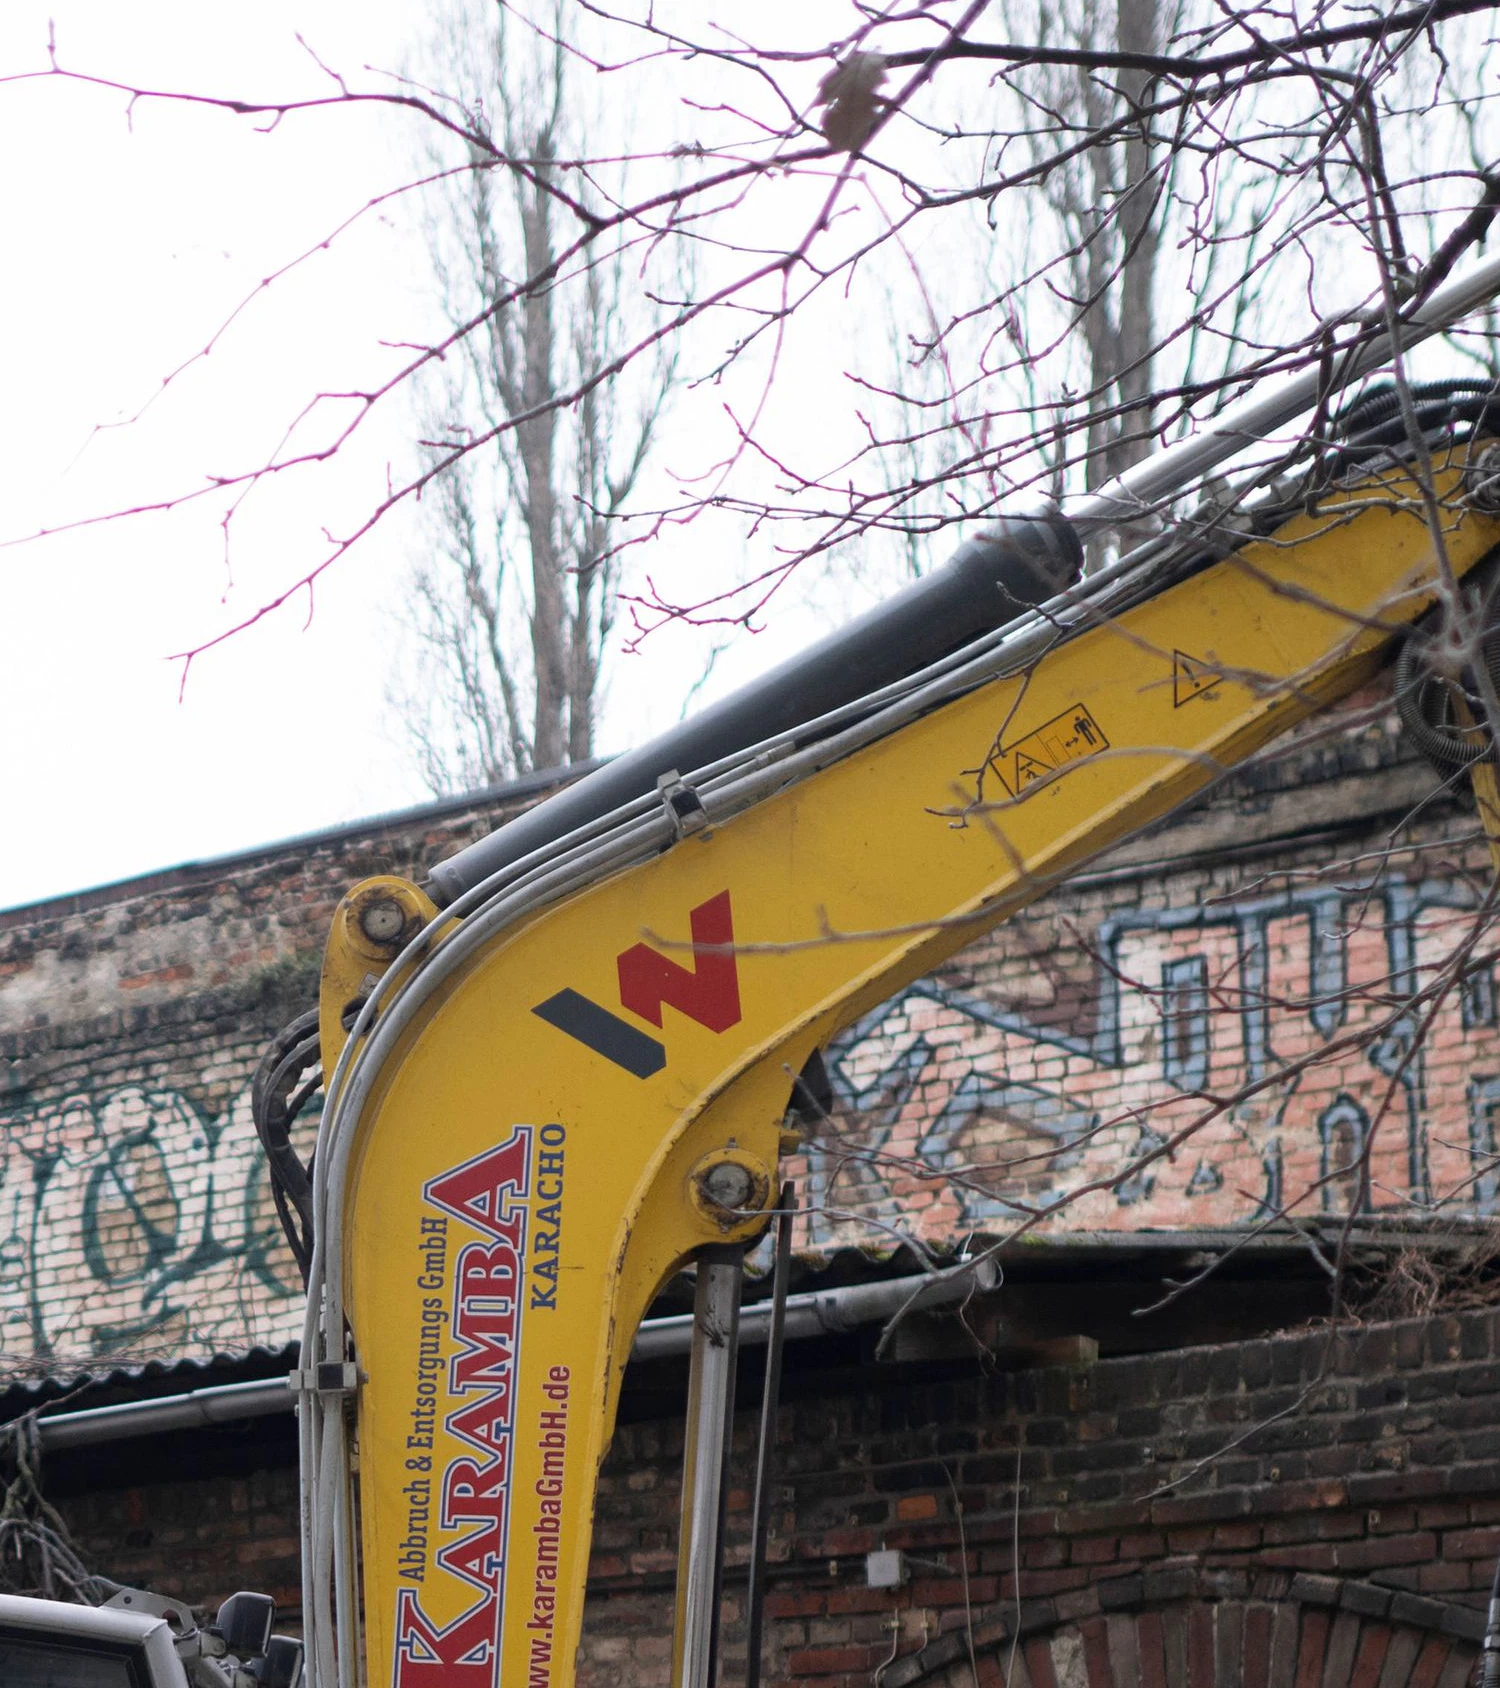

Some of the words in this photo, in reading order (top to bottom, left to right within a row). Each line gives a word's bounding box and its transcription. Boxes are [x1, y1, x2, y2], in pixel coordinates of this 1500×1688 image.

[417, 1217, 448, 1290] GmbH
[531, 1124, 566, 1310] KARACHO
[407, 1298, 449, 1450] Entsorgungs
[405, 1454, 433, 1472] &
[398, 1479, 431, 1583] Abbruch
